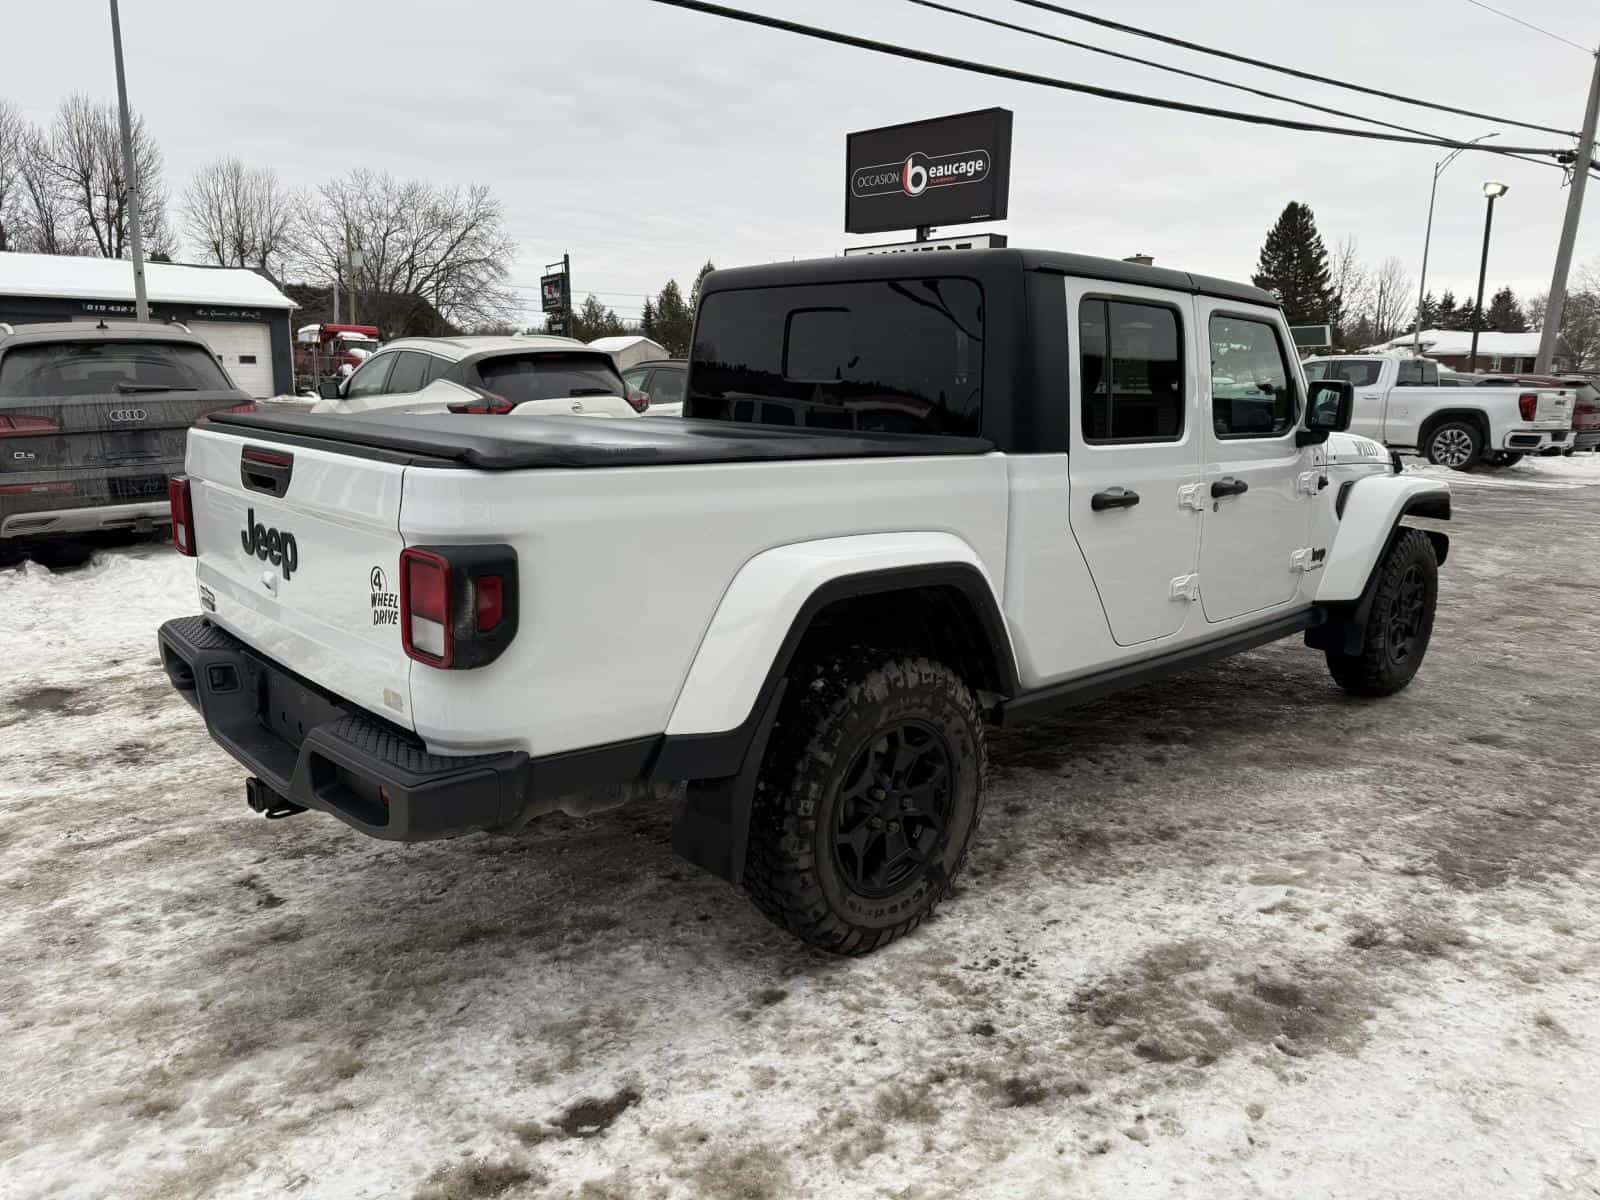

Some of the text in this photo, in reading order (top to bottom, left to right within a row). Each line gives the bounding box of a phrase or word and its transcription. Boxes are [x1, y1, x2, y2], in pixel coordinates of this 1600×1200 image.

[857, 172, 900, 189] OCCASION
[240, 507, 298, 581] Jeep
[372, 570, 383, 592] 4
[370, 592, 399, 609] WHEEL
[373, 609, 399, 626] DRIVE
